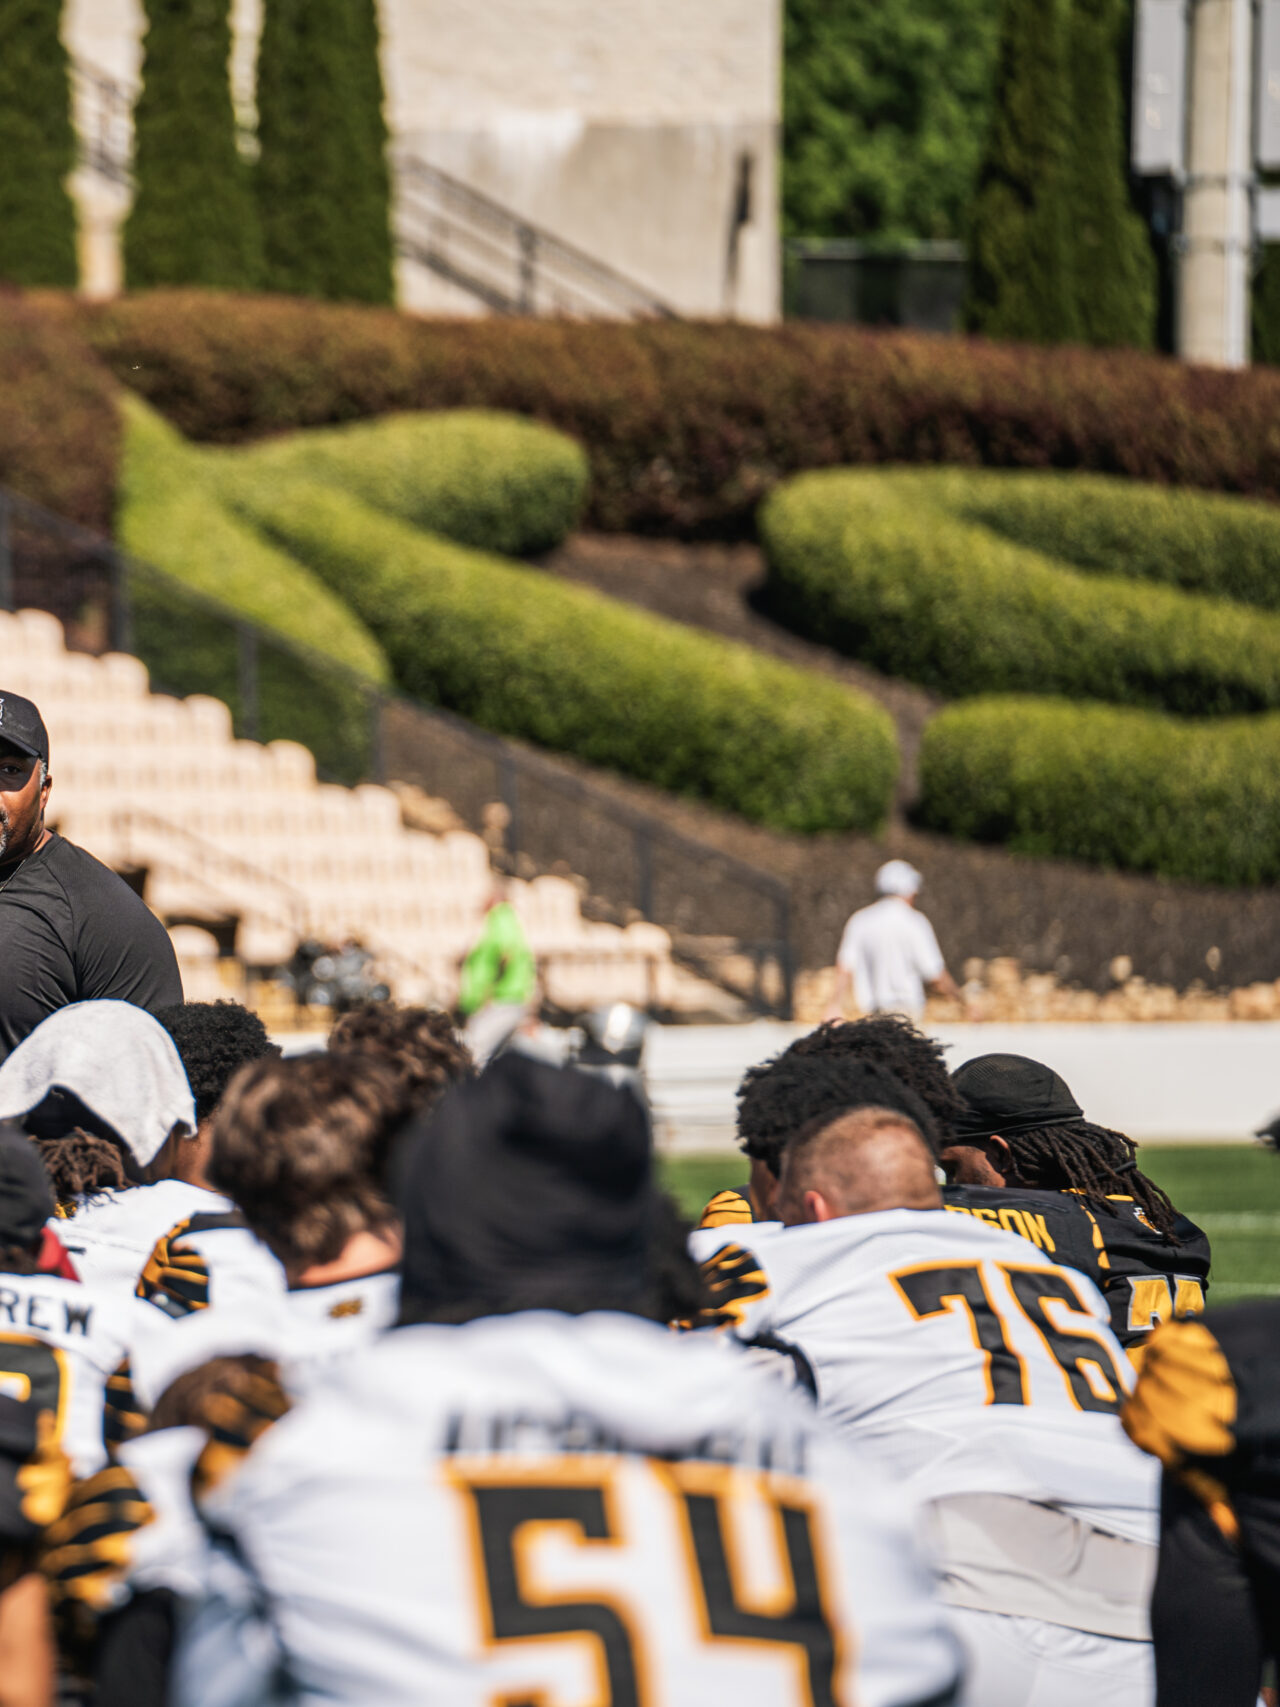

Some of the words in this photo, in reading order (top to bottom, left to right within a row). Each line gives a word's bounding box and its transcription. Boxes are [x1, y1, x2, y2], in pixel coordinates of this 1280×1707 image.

[944, 1204, 1057, 1253] SON
[887, 1258, 1134, 1414] 76
[432, 1450, 865, 1707] 54
